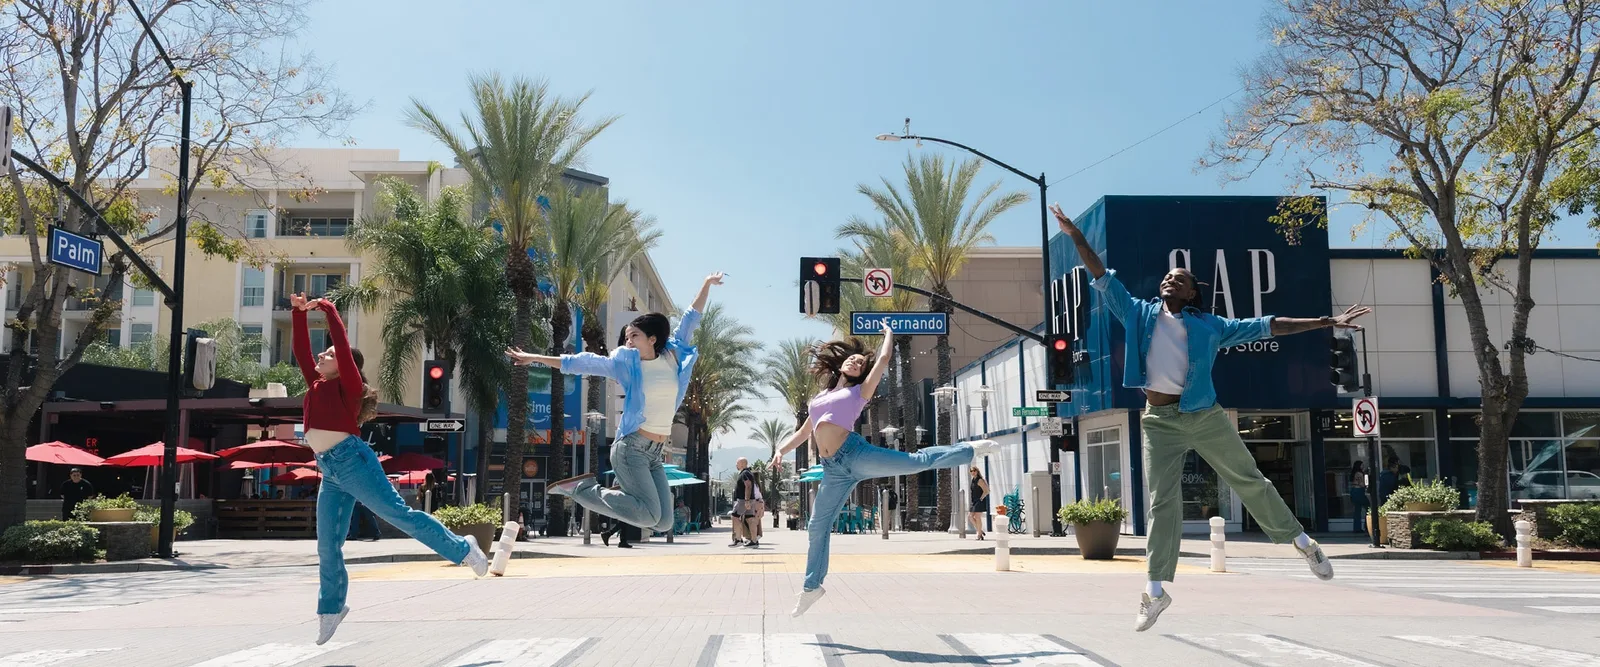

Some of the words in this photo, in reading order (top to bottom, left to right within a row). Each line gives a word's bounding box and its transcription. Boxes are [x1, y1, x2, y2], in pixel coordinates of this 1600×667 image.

[58, 235, 95, 265] Palm
[1169, 248, 1277, 320] AP
[856, 316, 880, 330] San
[1235, 341, 1280, 352] Store
[1039, 392, 1050, 400] ONE
[1050, 392, 1061, 400] WAY
[1181, 474, 1205, 484] 60%
